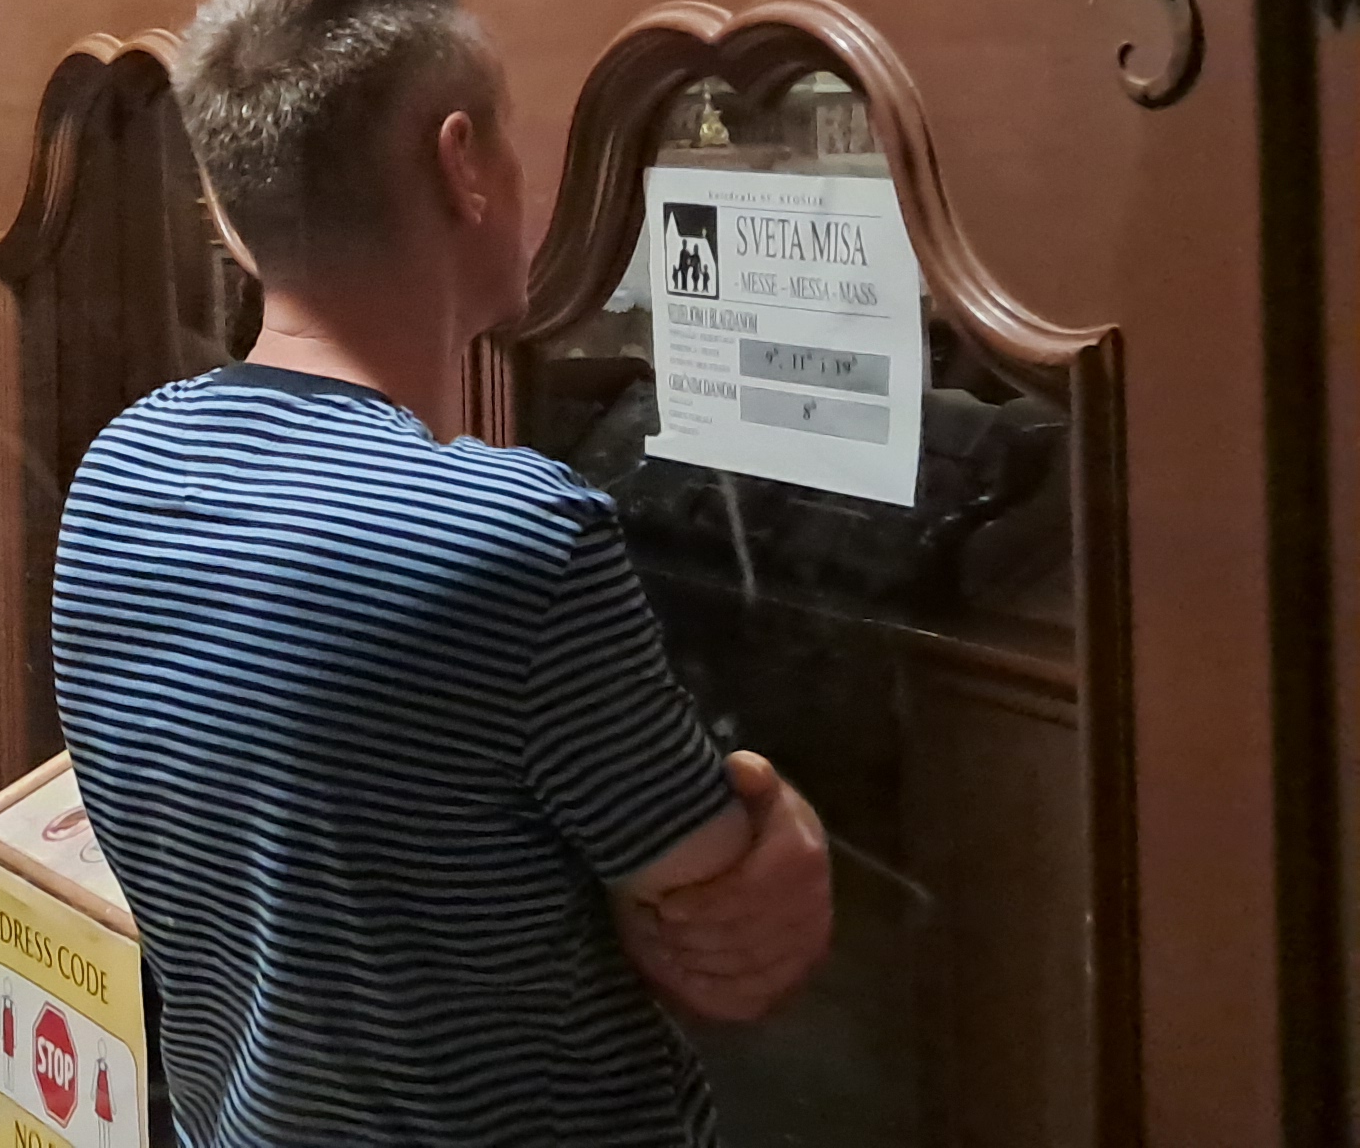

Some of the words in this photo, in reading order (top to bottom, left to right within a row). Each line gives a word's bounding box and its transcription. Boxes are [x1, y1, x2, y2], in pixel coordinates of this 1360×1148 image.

[735, 215, 807, 261] SVETA
[811, 220, 868, 266] MISA
[740, 271, 778, 296] MESSE
[789, 276, 830, 300] MESSA
[838, 281, 878, 306] MASS
[0, 911, 52, 969] DRESS
[57, 945, 109, 1005] CODE
[37, 1036, 74, 1091] STOP
[15, 1120, 41, 1148] NO
